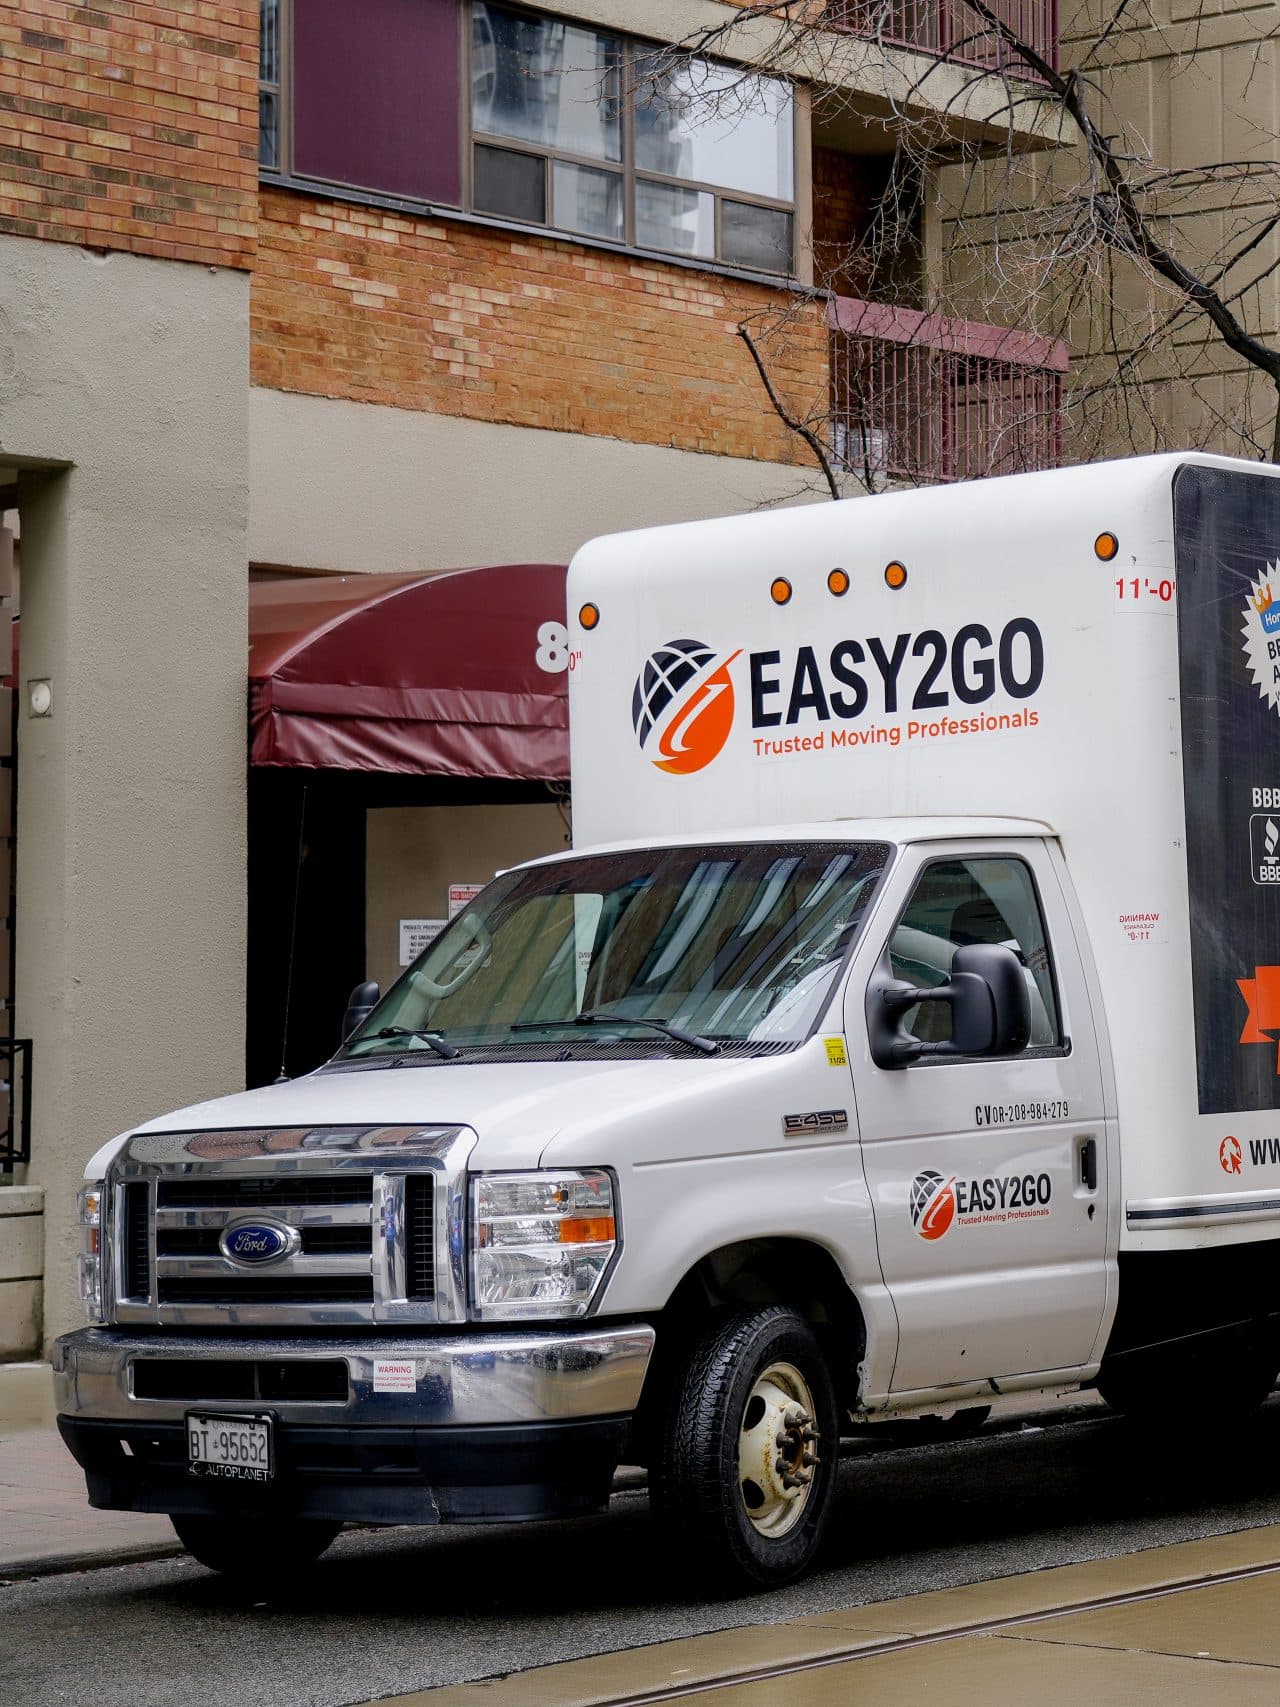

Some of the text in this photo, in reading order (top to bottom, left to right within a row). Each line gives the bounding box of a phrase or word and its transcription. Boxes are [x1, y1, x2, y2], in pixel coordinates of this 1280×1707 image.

[749, 617, 1044, 729] EASY2GO
[753, 708, 1038, 756] Trusted Moving Professionals
[955, 1173, 1051, 1214] EASY2GO
[958, 1208, 1049, 1225] Trusted Moving Professionals
[234, 1231, 268, 1252] Ford
[378, 1366, 411, 1374] WARNING
[190, 1430, 267, 1463] BT 95652
[205, 1464, 269, 1482] AUTOPLANET
